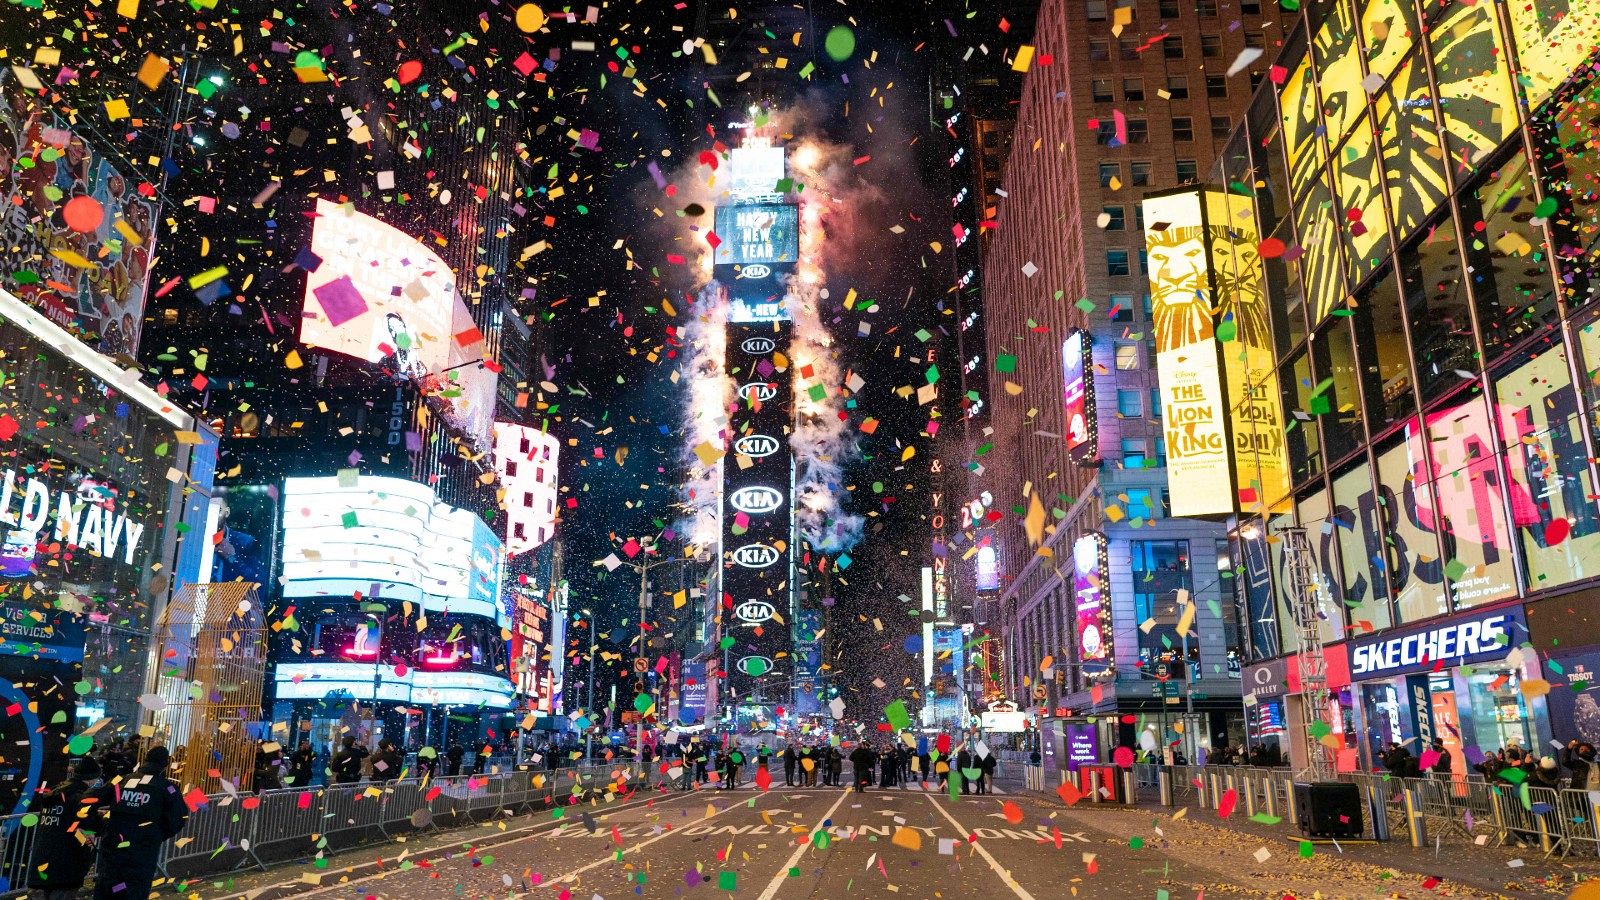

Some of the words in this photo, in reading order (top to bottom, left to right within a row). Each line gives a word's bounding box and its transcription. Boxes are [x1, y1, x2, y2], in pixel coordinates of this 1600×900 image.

[743, 228, 771, 242] NEW
[741, 243, 773, 258] YEAR
[747, 341, 770, 351] KIA
[1171, 384, 1203, 400] THE
[1167, 405, 1213, 429] LION
[741, 441, 772, 453] KIA
[1167, 430, 1222, 459] KING
[930, 459, 941, 473] &
[739, 492, 774, 508] KIA
[54, 491, 144, 565] NAVY
[1320, 460, 1457, 609] CBS
[741, 549, 772, 563] KIA
[742, 606, 770, 618] KIA
[1353, 616, 1508, 674] SKECHERS
[1567, 672, 1593, 682] TISSOT
[1071, 754, 1095, 762] happens
[121, 790, 151, 804] NYPD
[681, 824, 797, 837] ONLY
[828, 825, 943, 838] ONY
[974, 828, 1092, 843] ONLY
